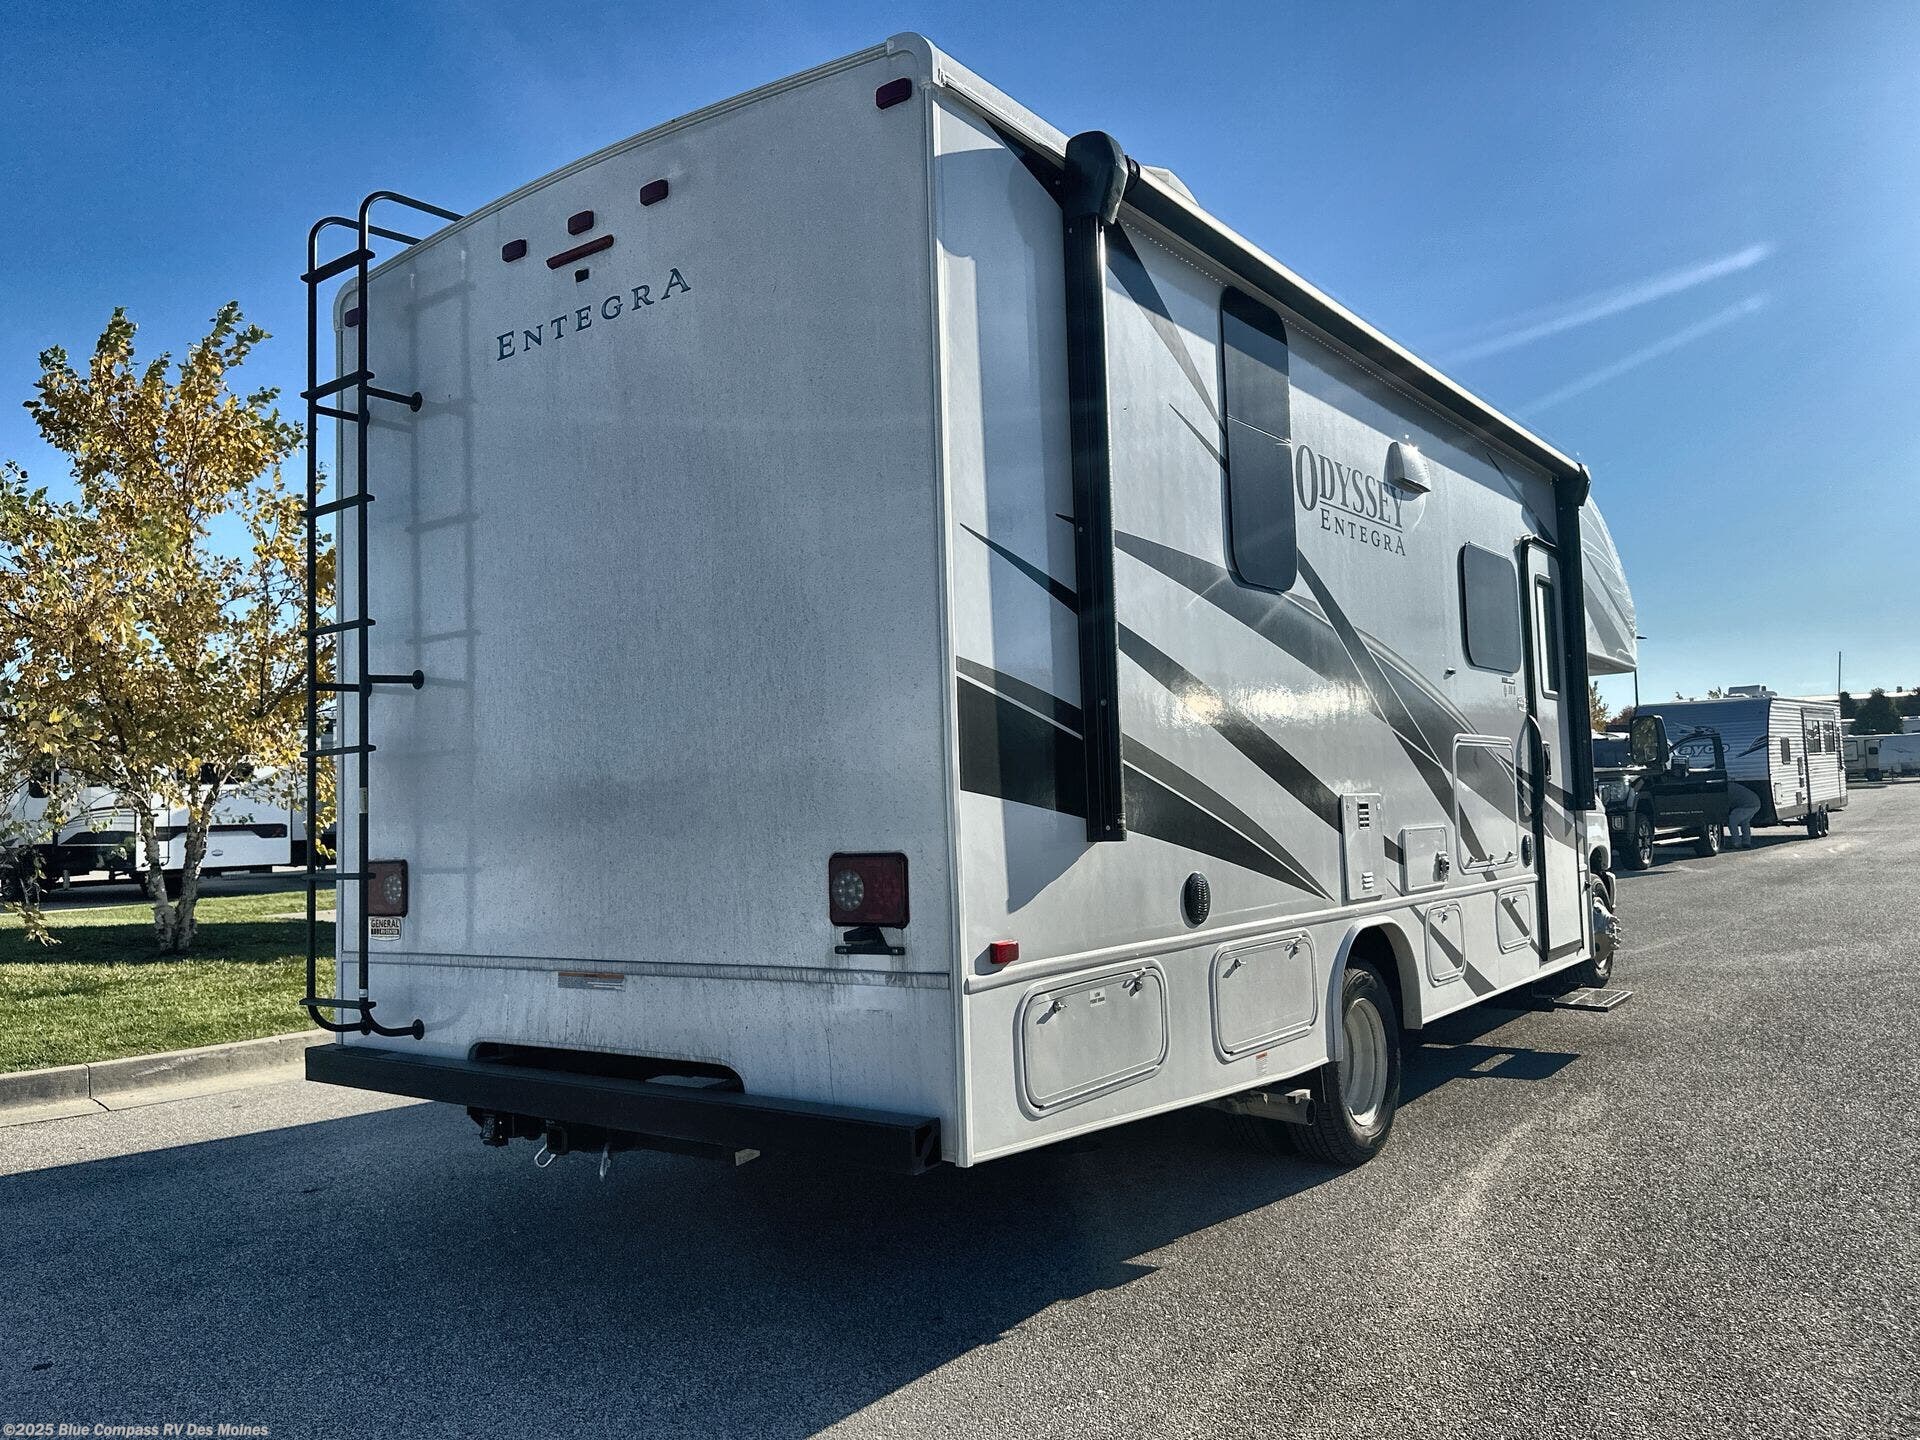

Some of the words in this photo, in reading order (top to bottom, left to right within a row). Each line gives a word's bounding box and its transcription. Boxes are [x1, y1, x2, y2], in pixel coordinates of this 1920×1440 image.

[496, 267, 692, 362] ENTEGRA
[1295, 444, 1404, 529] ODYSSEY
[1319, 507, 1406, 557] ENTEGRA
[371, 919, 399, 927] GENERAL
